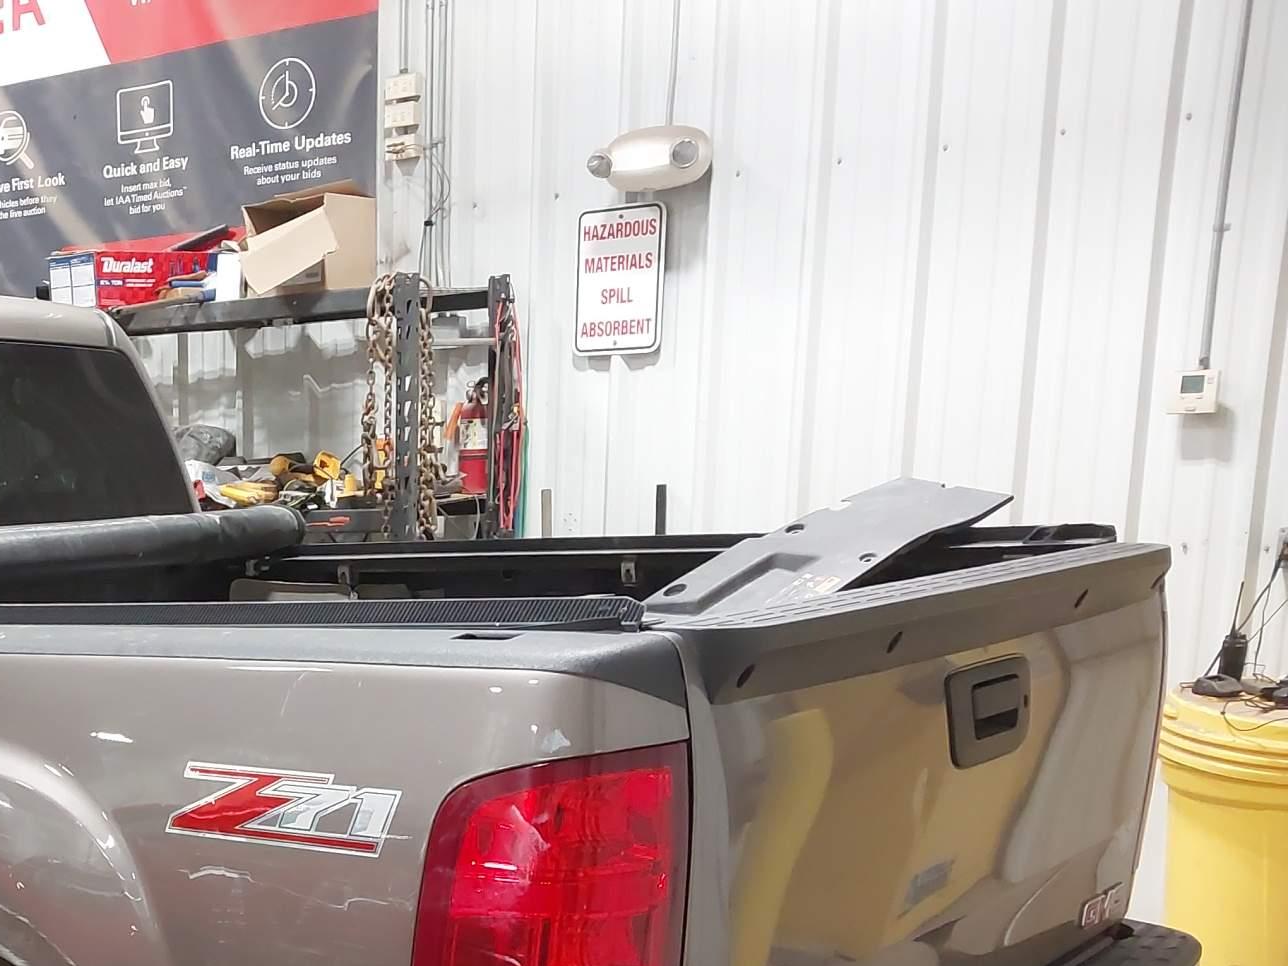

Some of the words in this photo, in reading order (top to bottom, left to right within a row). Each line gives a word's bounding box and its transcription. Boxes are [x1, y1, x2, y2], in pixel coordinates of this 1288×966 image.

[230, 140, 290, 160] Real-Time
[294, 132, 352, 152] Updates
[103, 162, 138, 179] Quick
[139, 158, 161, 173] and
[162, 156, 189, 171] Easy
[244, 163, 273, 176] Receive
[274, 160, 299, 172] status
[302, 156, 337, 169] updates
[12, 178, 34, 191] First
[38, 172, 66, 188] Look
[256, 174, 279, 186] about
[280, 172, 300, 184] your
[302, 168, 322, 180] bids
[20, 196, 40, 206] before
[130, 192, 153, 203] Timed
[129, 205, 141, 215] bid
[141, 203, 152, 213] for
[152, 202, 166, 213] you
[583, 218, 657, 242] HAZARDOUS
[100, 256, 154, 273] Duralast
[584, 252, 654, 274] MATERIALS
[601, 287, 633, 305] SPILL
[580, 318, 652, 338] ABSORBENT
[165, 760, 403, 859] Z71
